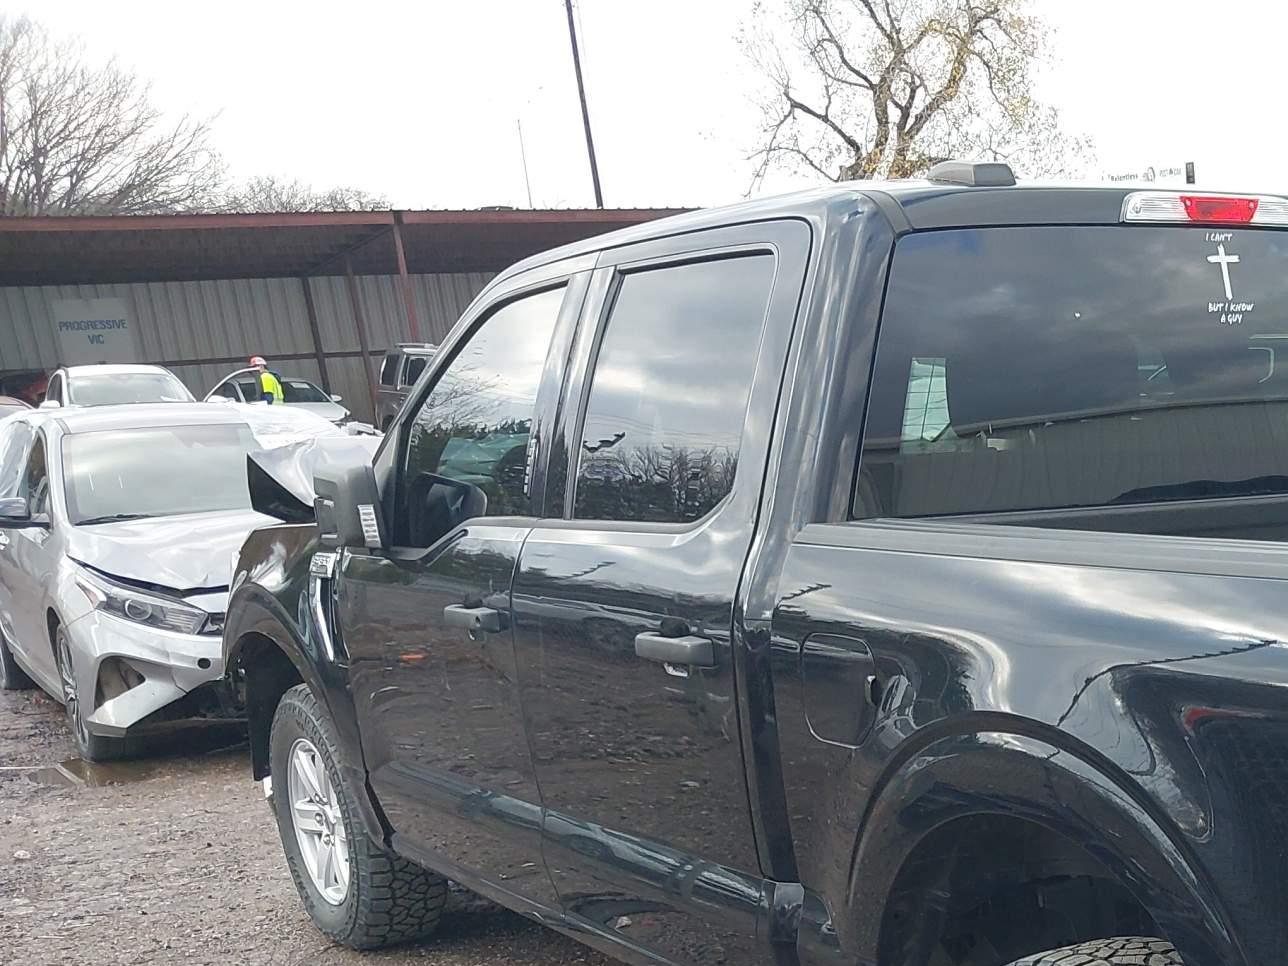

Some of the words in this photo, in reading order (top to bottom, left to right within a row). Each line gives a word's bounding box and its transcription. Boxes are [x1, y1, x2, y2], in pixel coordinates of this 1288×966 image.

[1205, 231, 1209, 241] I
[1210, 232, 1233, 241] CAN'T
[1208, 302, 1224, 313] BUT
[1224, 302, 1229, 312] I
[1230, 302, 1254, 312] KNOW
[1220, 313, 1226, 323] A
[1227, 313, 1243, 325] GUY
[58, 319, 128, 332] PROGRESSIVE
[87, 334, 105, 345] VIC
